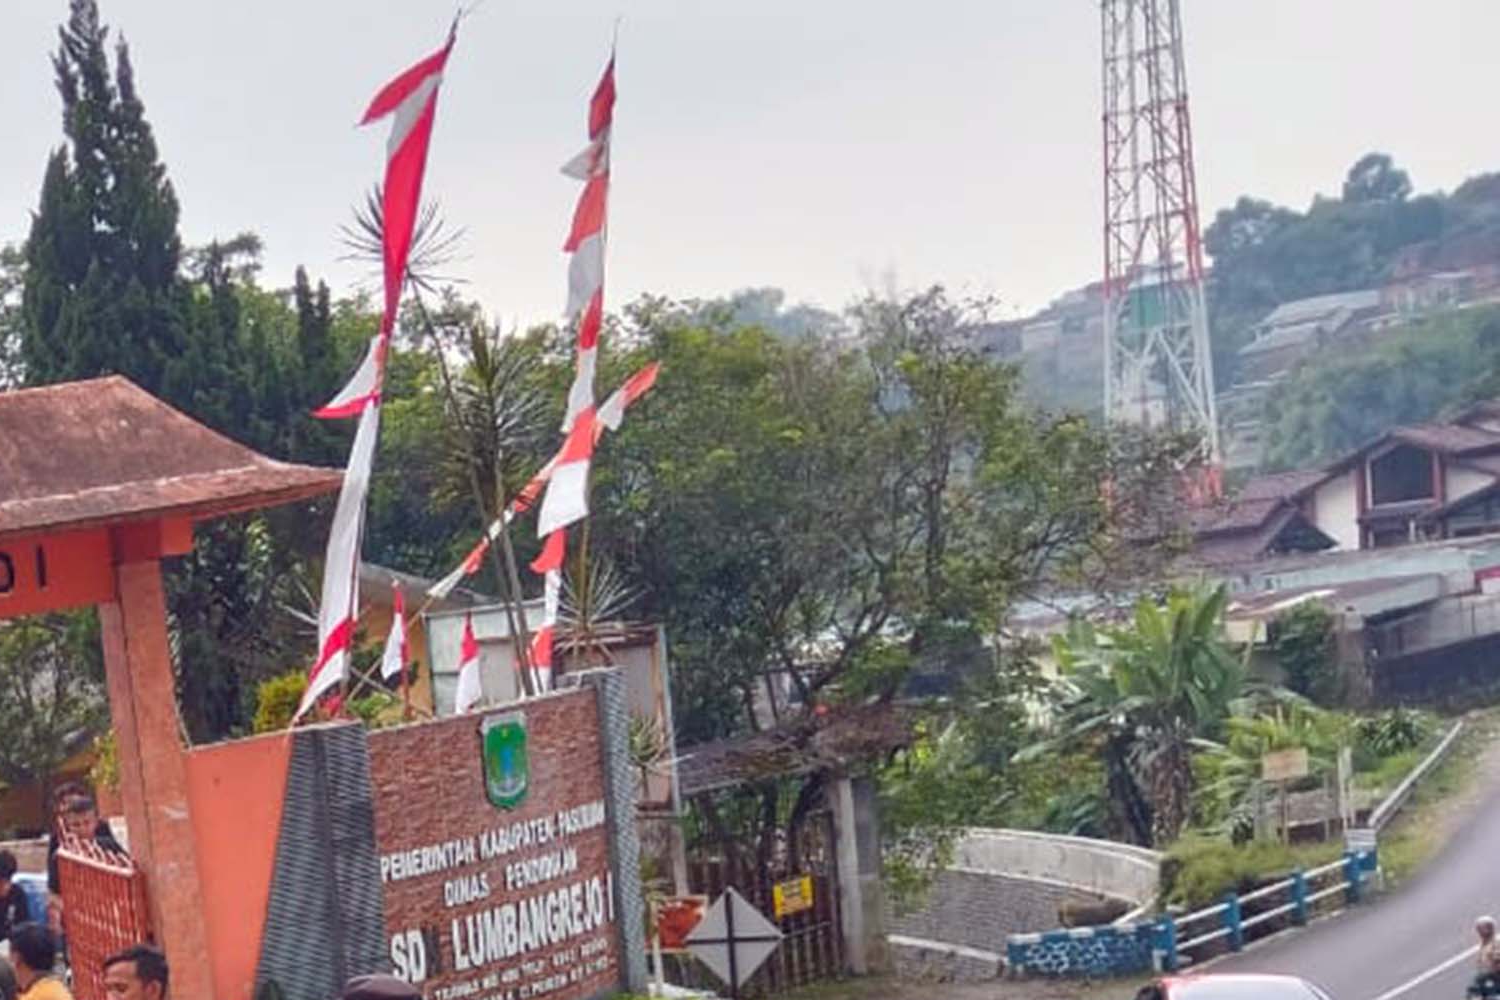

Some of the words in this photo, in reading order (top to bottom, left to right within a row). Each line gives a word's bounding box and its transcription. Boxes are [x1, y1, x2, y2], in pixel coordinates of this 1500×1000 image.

[34, 545, 49, 588] I
[380, 839, 476, 882] PEMERINTAH
[444, 872, 491, 907] DINAS
[451, 875, 603, 971] LUMBANGREJO
